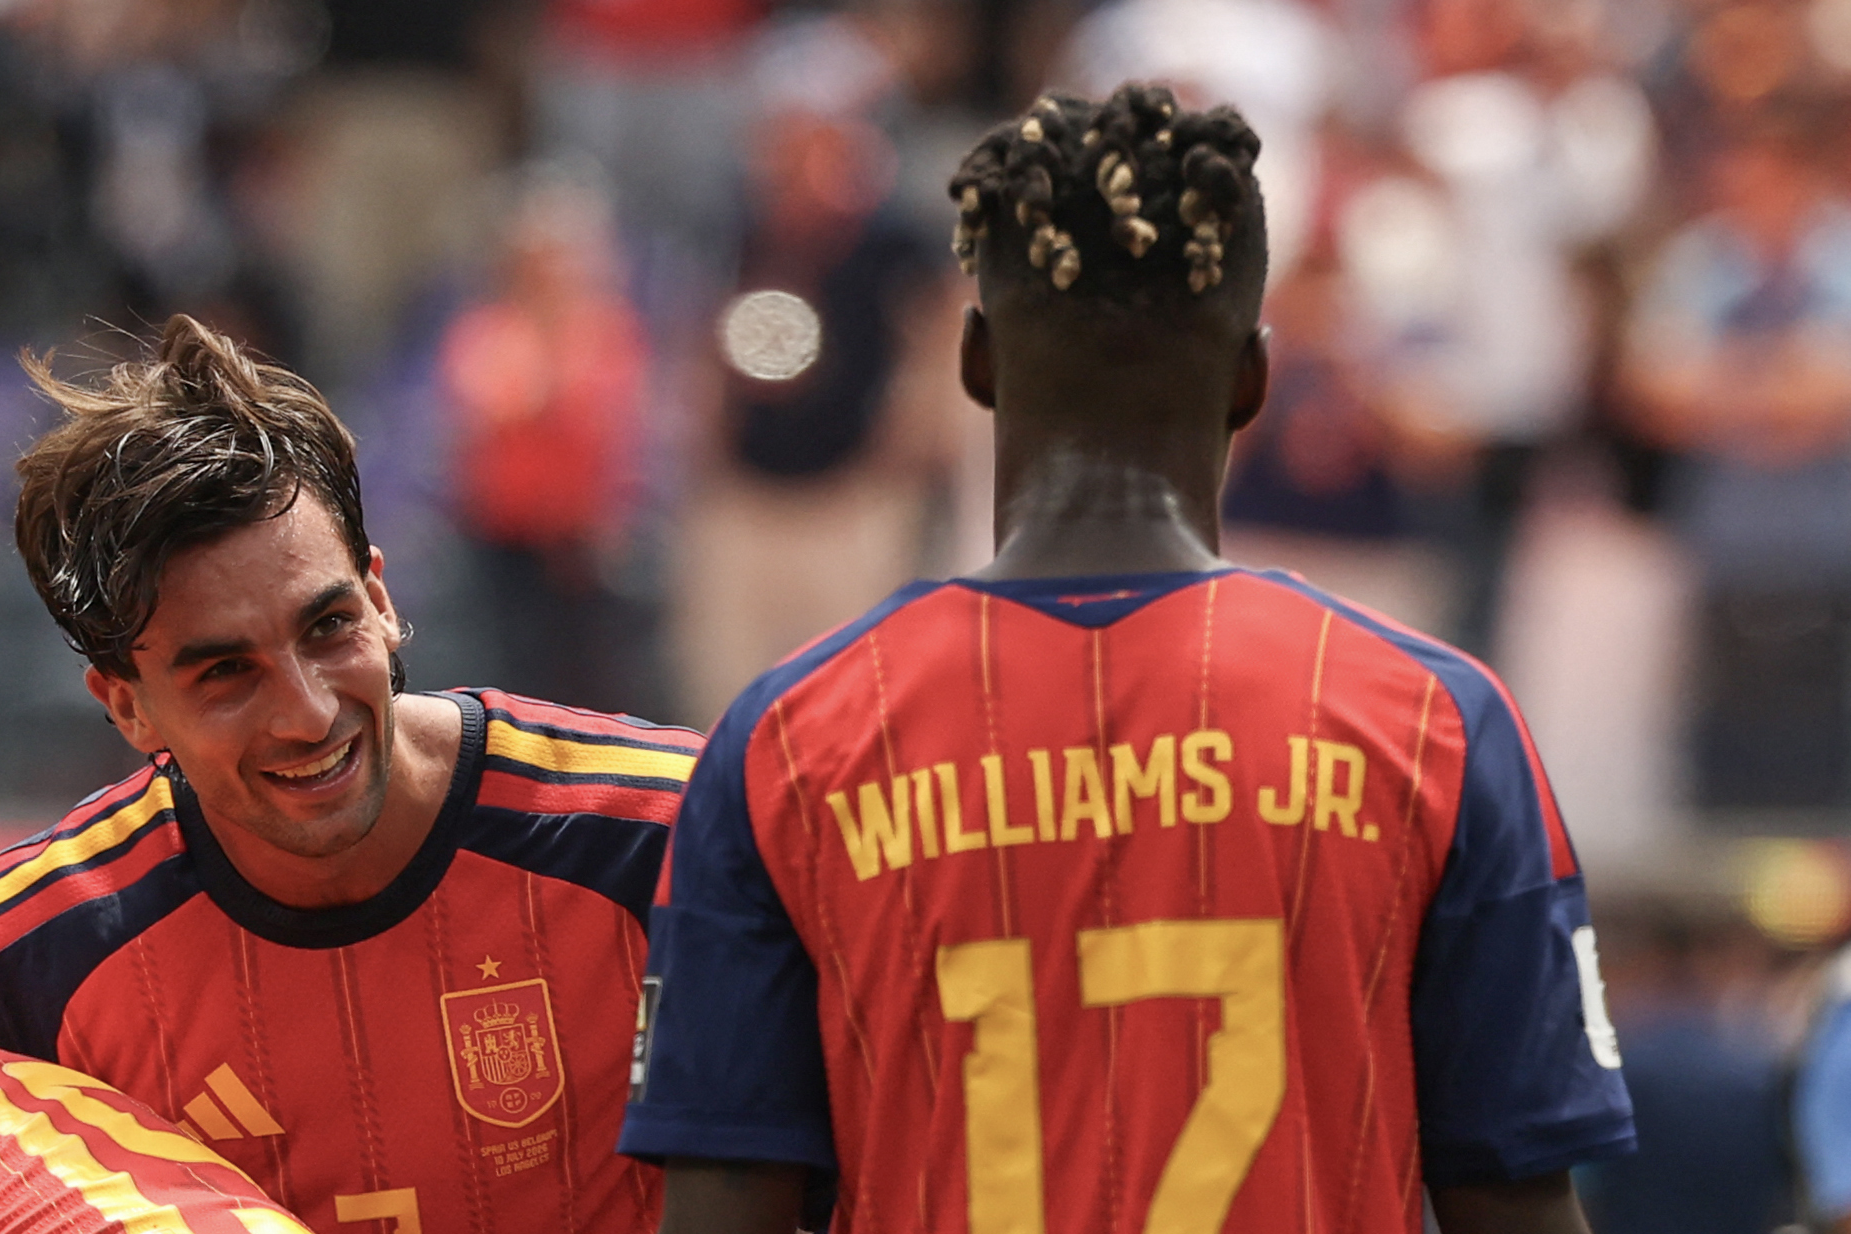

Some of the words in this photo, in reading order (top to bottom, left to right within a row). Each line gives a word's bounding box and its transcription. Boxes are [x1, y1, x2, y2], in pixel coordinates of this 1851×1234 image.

[827, 729, 1233, 882] WILLIAMS
[1258, 736, 1380, 841] JR.
[506, 1151, 525, 1163] JULY
[496, 1165, 512, 1177] LOS
